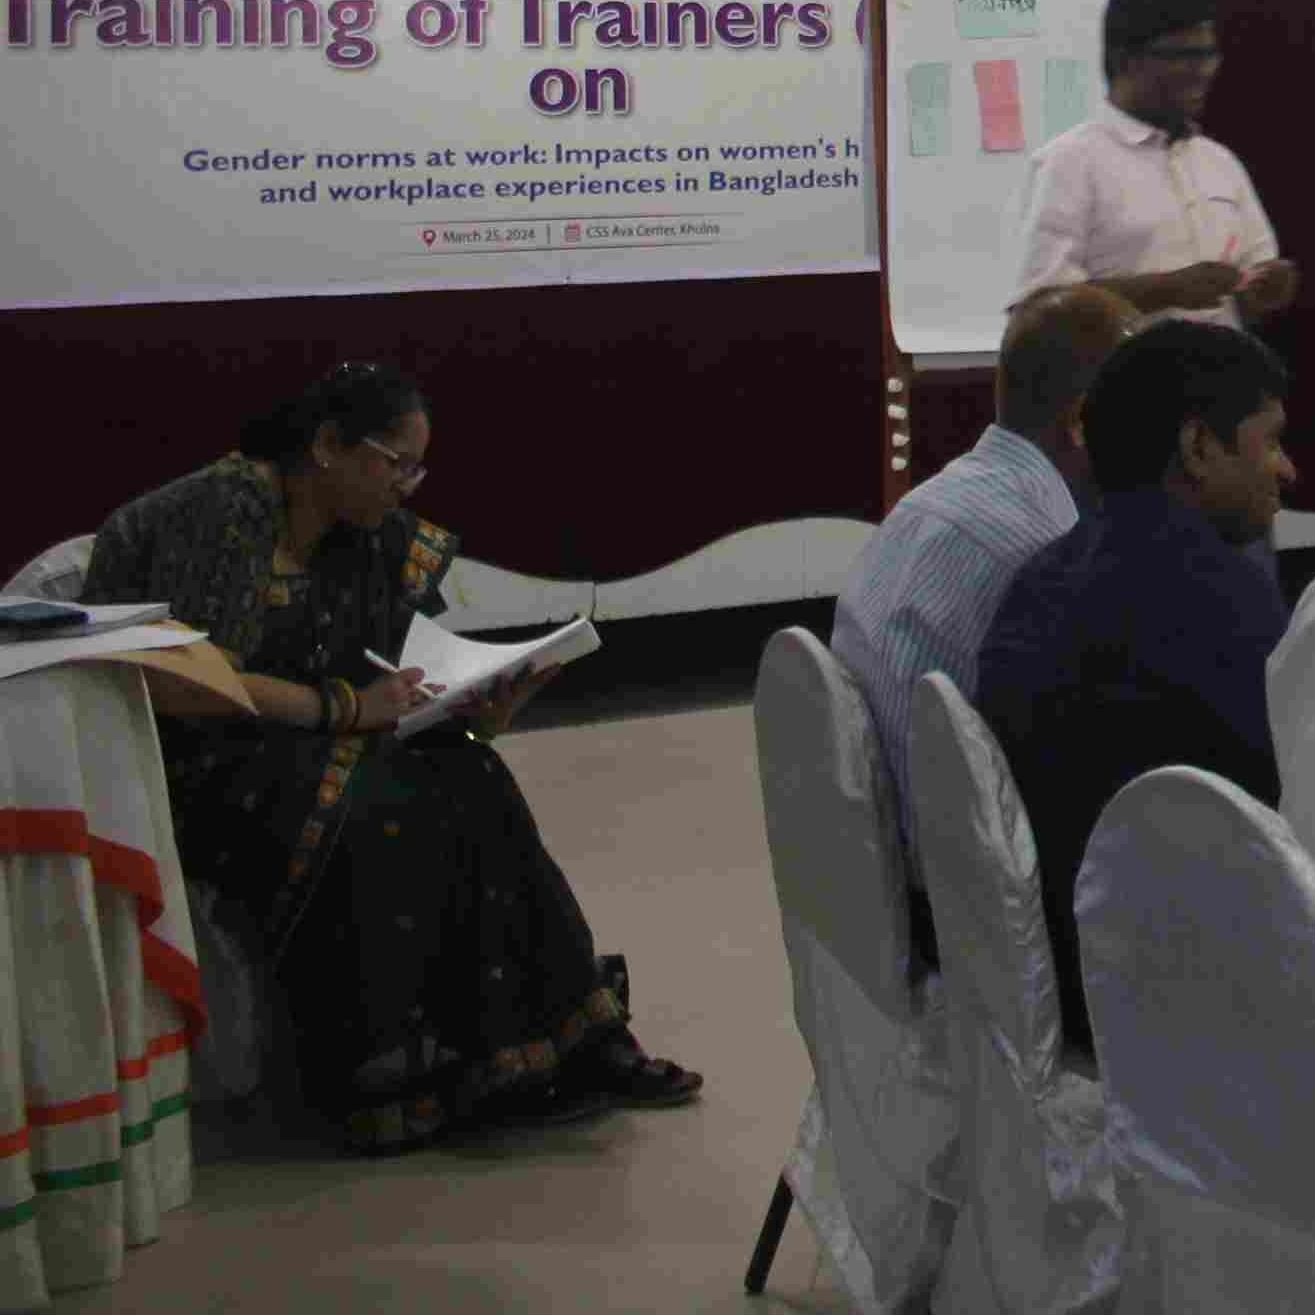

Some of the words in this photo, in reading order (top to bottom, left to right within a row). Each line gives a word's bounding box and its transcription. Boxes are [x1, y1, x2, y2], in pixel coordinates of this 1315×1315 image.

[528, 66, 629, 115] on
[183, 149, 305, 172] Gender
[316, 150, 416, 170] norms
[426, 148, 456, 168] at
[465, 143, 547, 166] work:
[556, 144, 668, 169] Impacts
[677, 146, 710, 162] on
[720, 138, 837, 160] women's
[260, 181, 317, 204] and
[328, 178, 485, 205] workplace
[495, 173, 666, 202] experiences
[675, 172, 699, 192] in
[709, 168, 859, 195] Bangladesh
